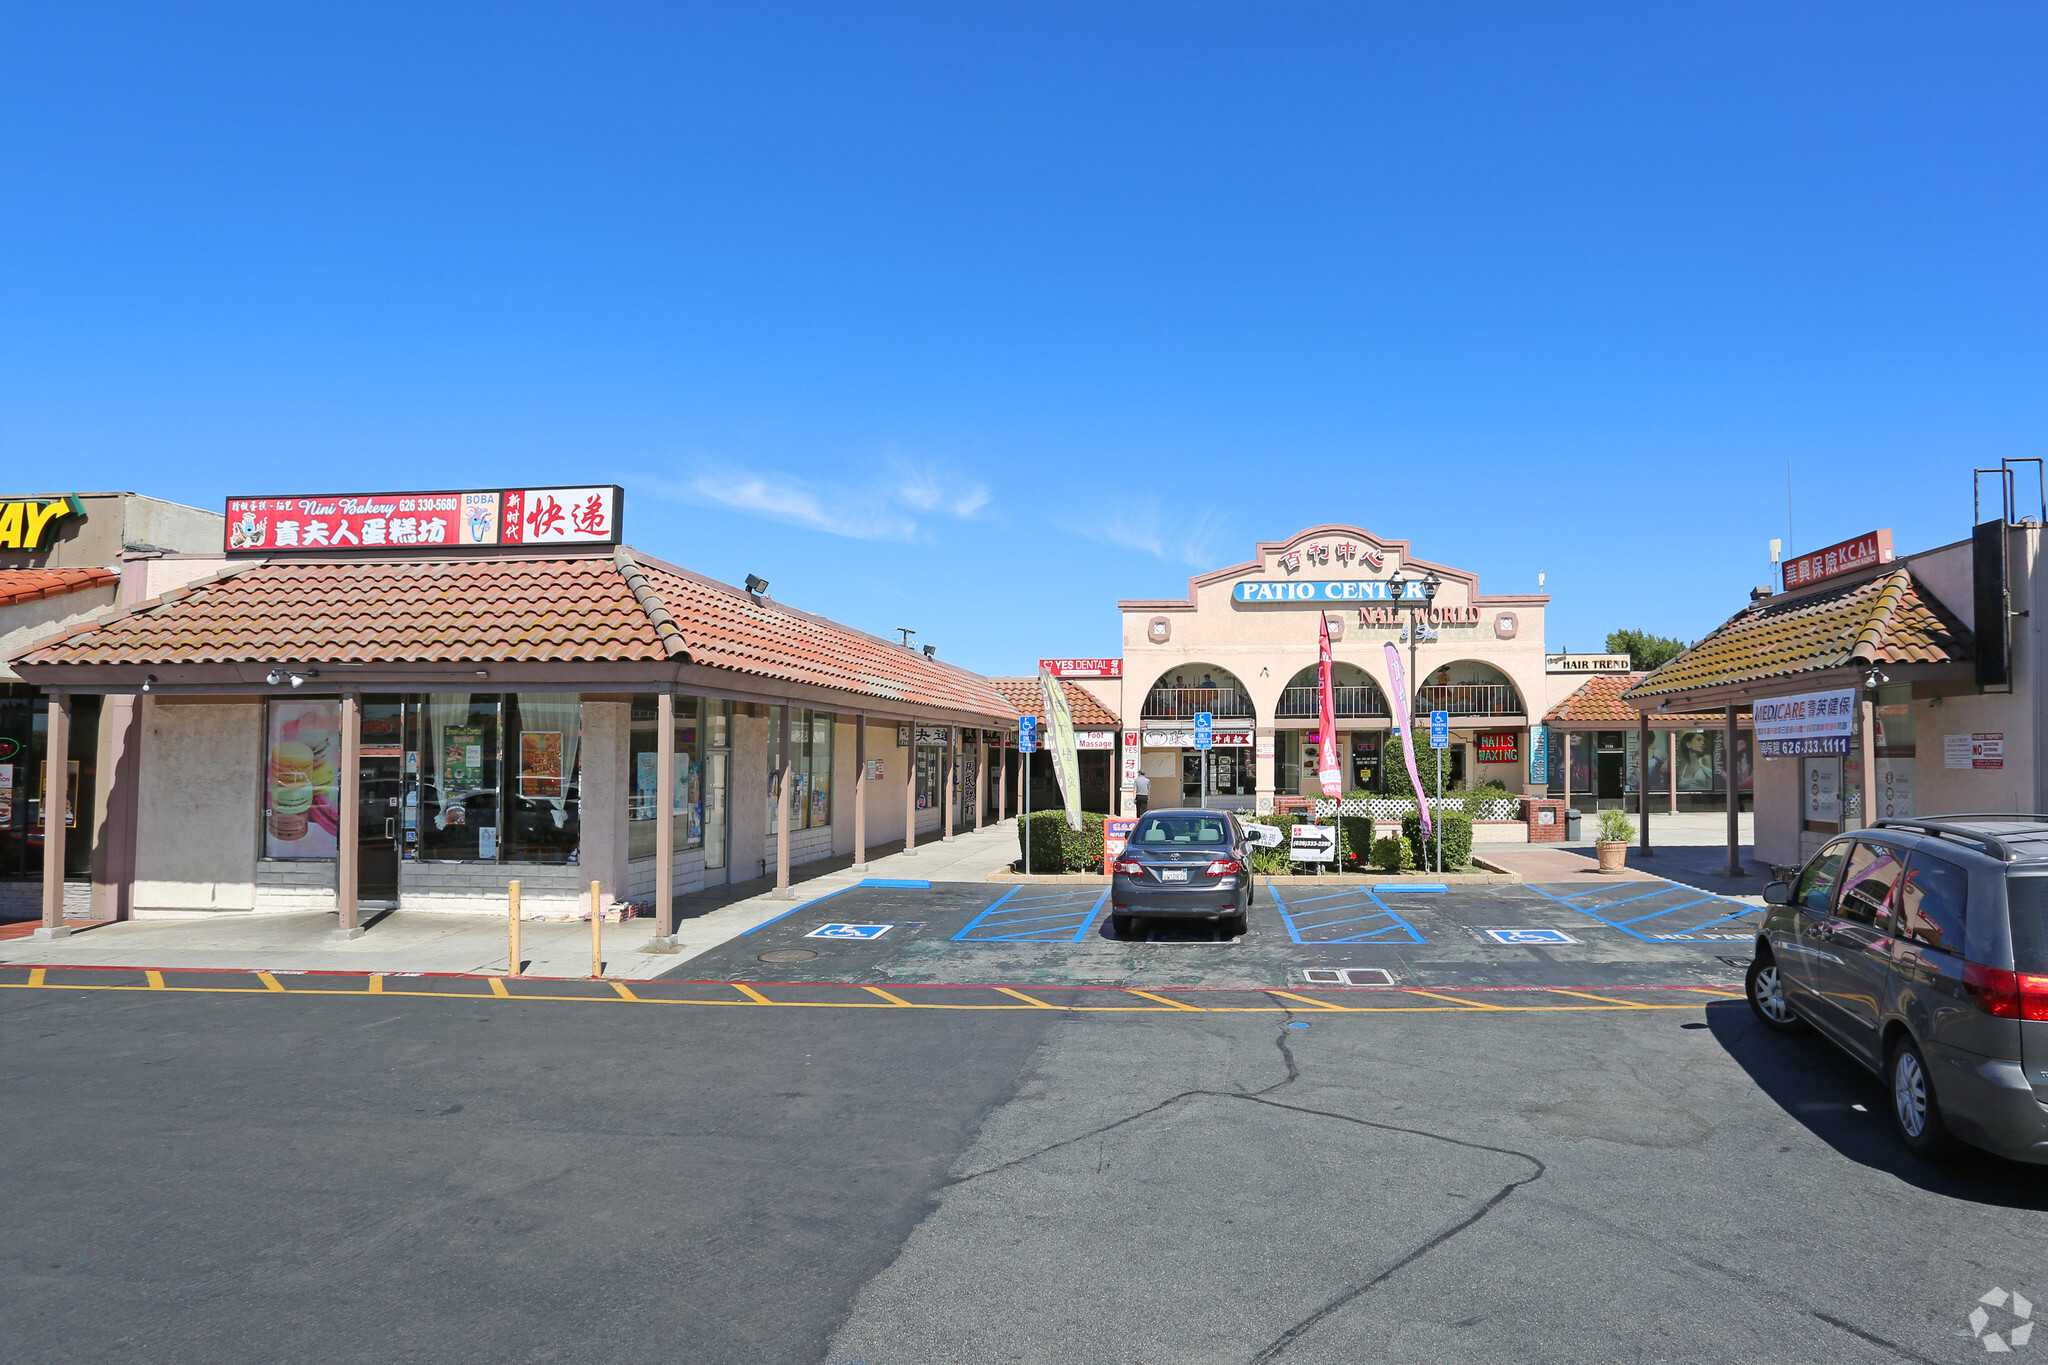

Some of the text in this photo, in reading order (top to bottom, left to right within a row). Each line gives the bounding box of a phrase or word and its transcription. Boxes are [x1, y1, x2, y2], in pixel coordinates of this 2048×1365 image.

[298, 498, 457, 519] Nini Bakery 626 330-5680
[466, 494, 494, 504] BOBA
[0, 497, 70, 548] AY
[506, 493, 521, 540] 新时代
[526, 492, 610, 538] 快递
[274, 516, 447, 547] 貴夫人蛋糕坊
[1279, 541, 1385, 571] 百利中心
[1839, 539, 1876, 563] KCAL
[1786, 551, 1838, 586] 華興保險
[1243, 583, 1315, 600] PATIO
[1414, 605, 1481, 624] WORLD
[1055, 660, 1108, 669] YES DENTAL
[1563, 660, 1629, 669] HAIR TREND
[1755, 701, 1806, 723] MEDICARE
[467, 728, 482, 736] Combo
[1481, 736, 1514, 747] NAILS
[1079, 740, 1112, 748] Massage
[1533, 734, 1545, 758] BEAUTY
[1548, 734, 1557, 754] Skin
[1972, 744, 1982, 755] NO
[408, 753, 417, 763] A
[1478, 749, 1518, 761] WAXING
[1125, 759, 1136, 780] 牙科
[1533, 759, 1545, 782] SUPPLY
